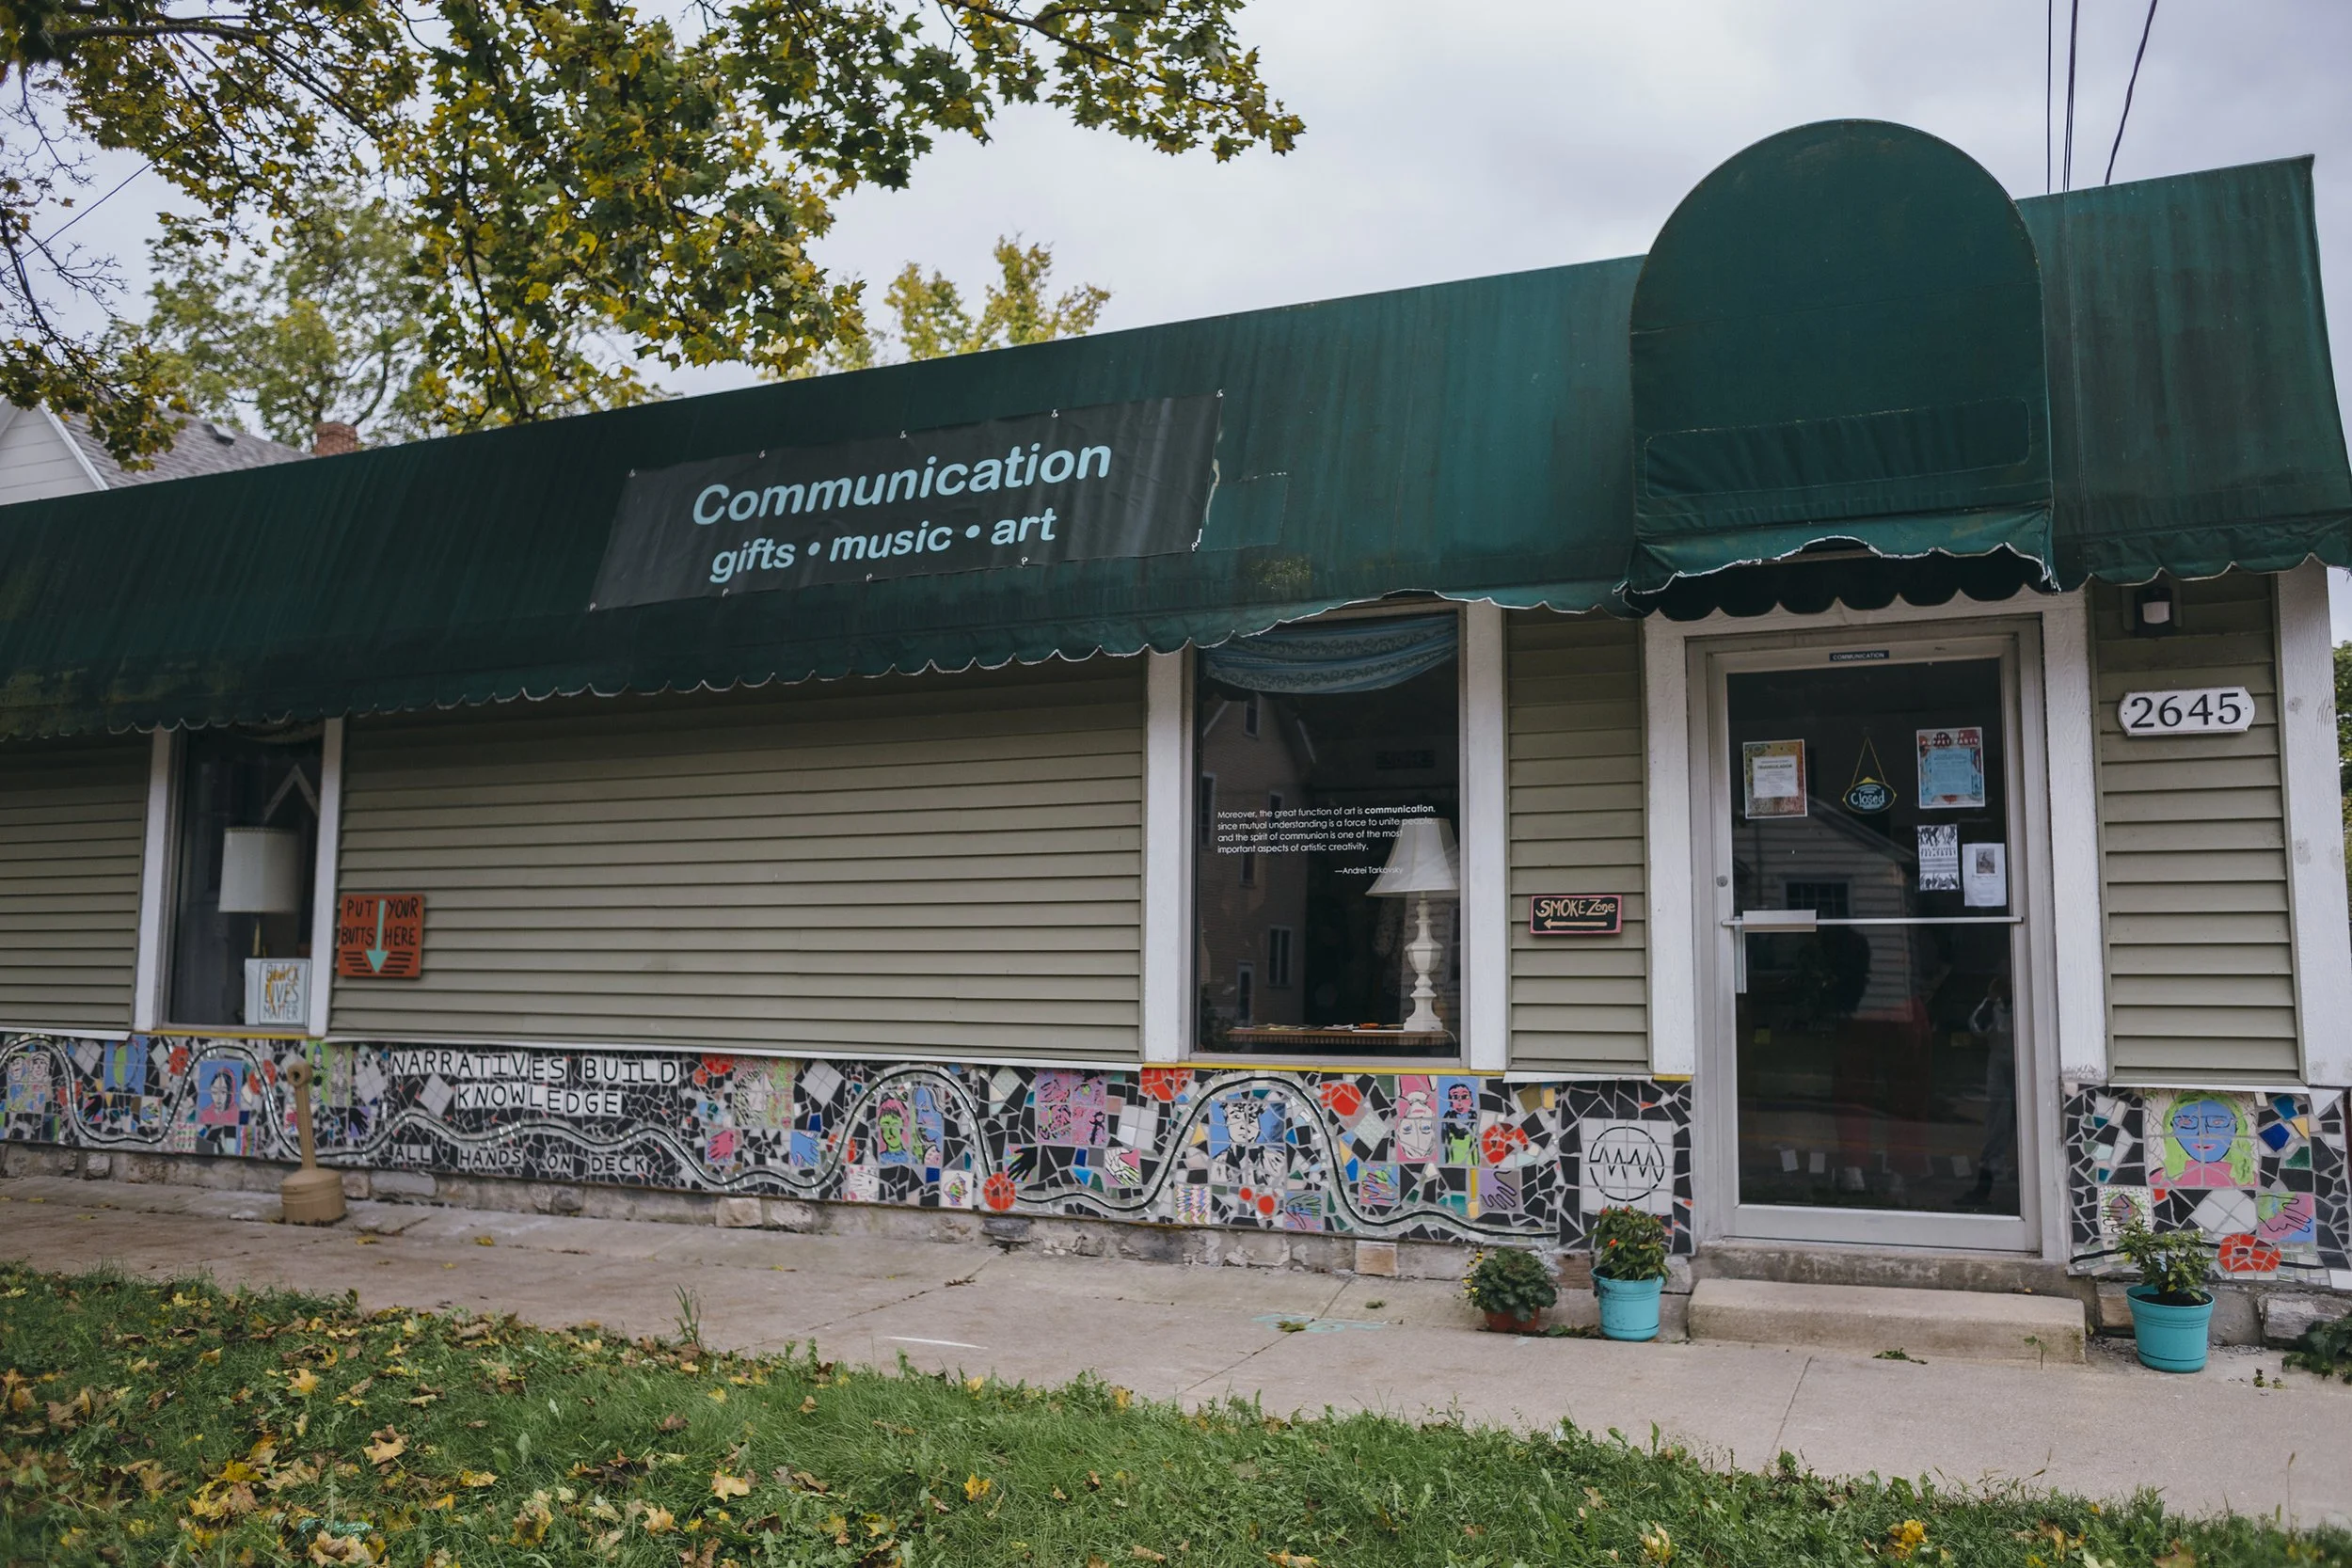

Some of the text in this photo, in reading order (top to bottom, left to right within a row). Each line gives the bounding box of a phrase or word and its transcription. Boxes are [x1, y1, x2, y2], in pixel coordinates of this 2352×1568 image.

[691, 441, 1112, 526] Communication
[709, 506, 1056, 583] gifts music art
[1832, 652, 1884, 660] COMMUNICATION
[2130, 691, 2242, 729] 2645
[1851, 790, 1885, 805] Closed
[1274, 809, 1296, 818] great
[1298, 808, 1331, 816] function
[1333, 807, 1343, 816] of
[1357, 806, 1363, 815] is
[1217, 822, 1238, 831] since
[1239, 821, 1267, 830] mutual
[1268, 819, 1327, 829] understanding
[1328, 818, 1335, 827] is
[1343, 817, 1367, 827] force
[1378, 817, 1400, 826] unite
[1250, 832, 1268, 842] spirit
[1269, 832, 1279, 841] of
[1279, 831, 1328, 840] communion
[1329, 831, 1336, 839] is
[1366, 830, 1380, 838] the
[1382, 829, 1403, 838] most
[1217, 842, 1369, 854] important aspects of artistic creativity.
[1368, 865, 1404, 875] Tarkovsky
[346, 897, 419, 919] PUT YOUR
[1535, 898, 1616, 917] SMOKE Zone
[341, 927, 417, 946] BUTTS HERE
[391, 1051, 677, 1083] NARRATIVES BUILD
[457, 1085, 621, 1114] KNOWLEDGE
[393, 1144, 646, 1173] ALL HANDS ON DECK
